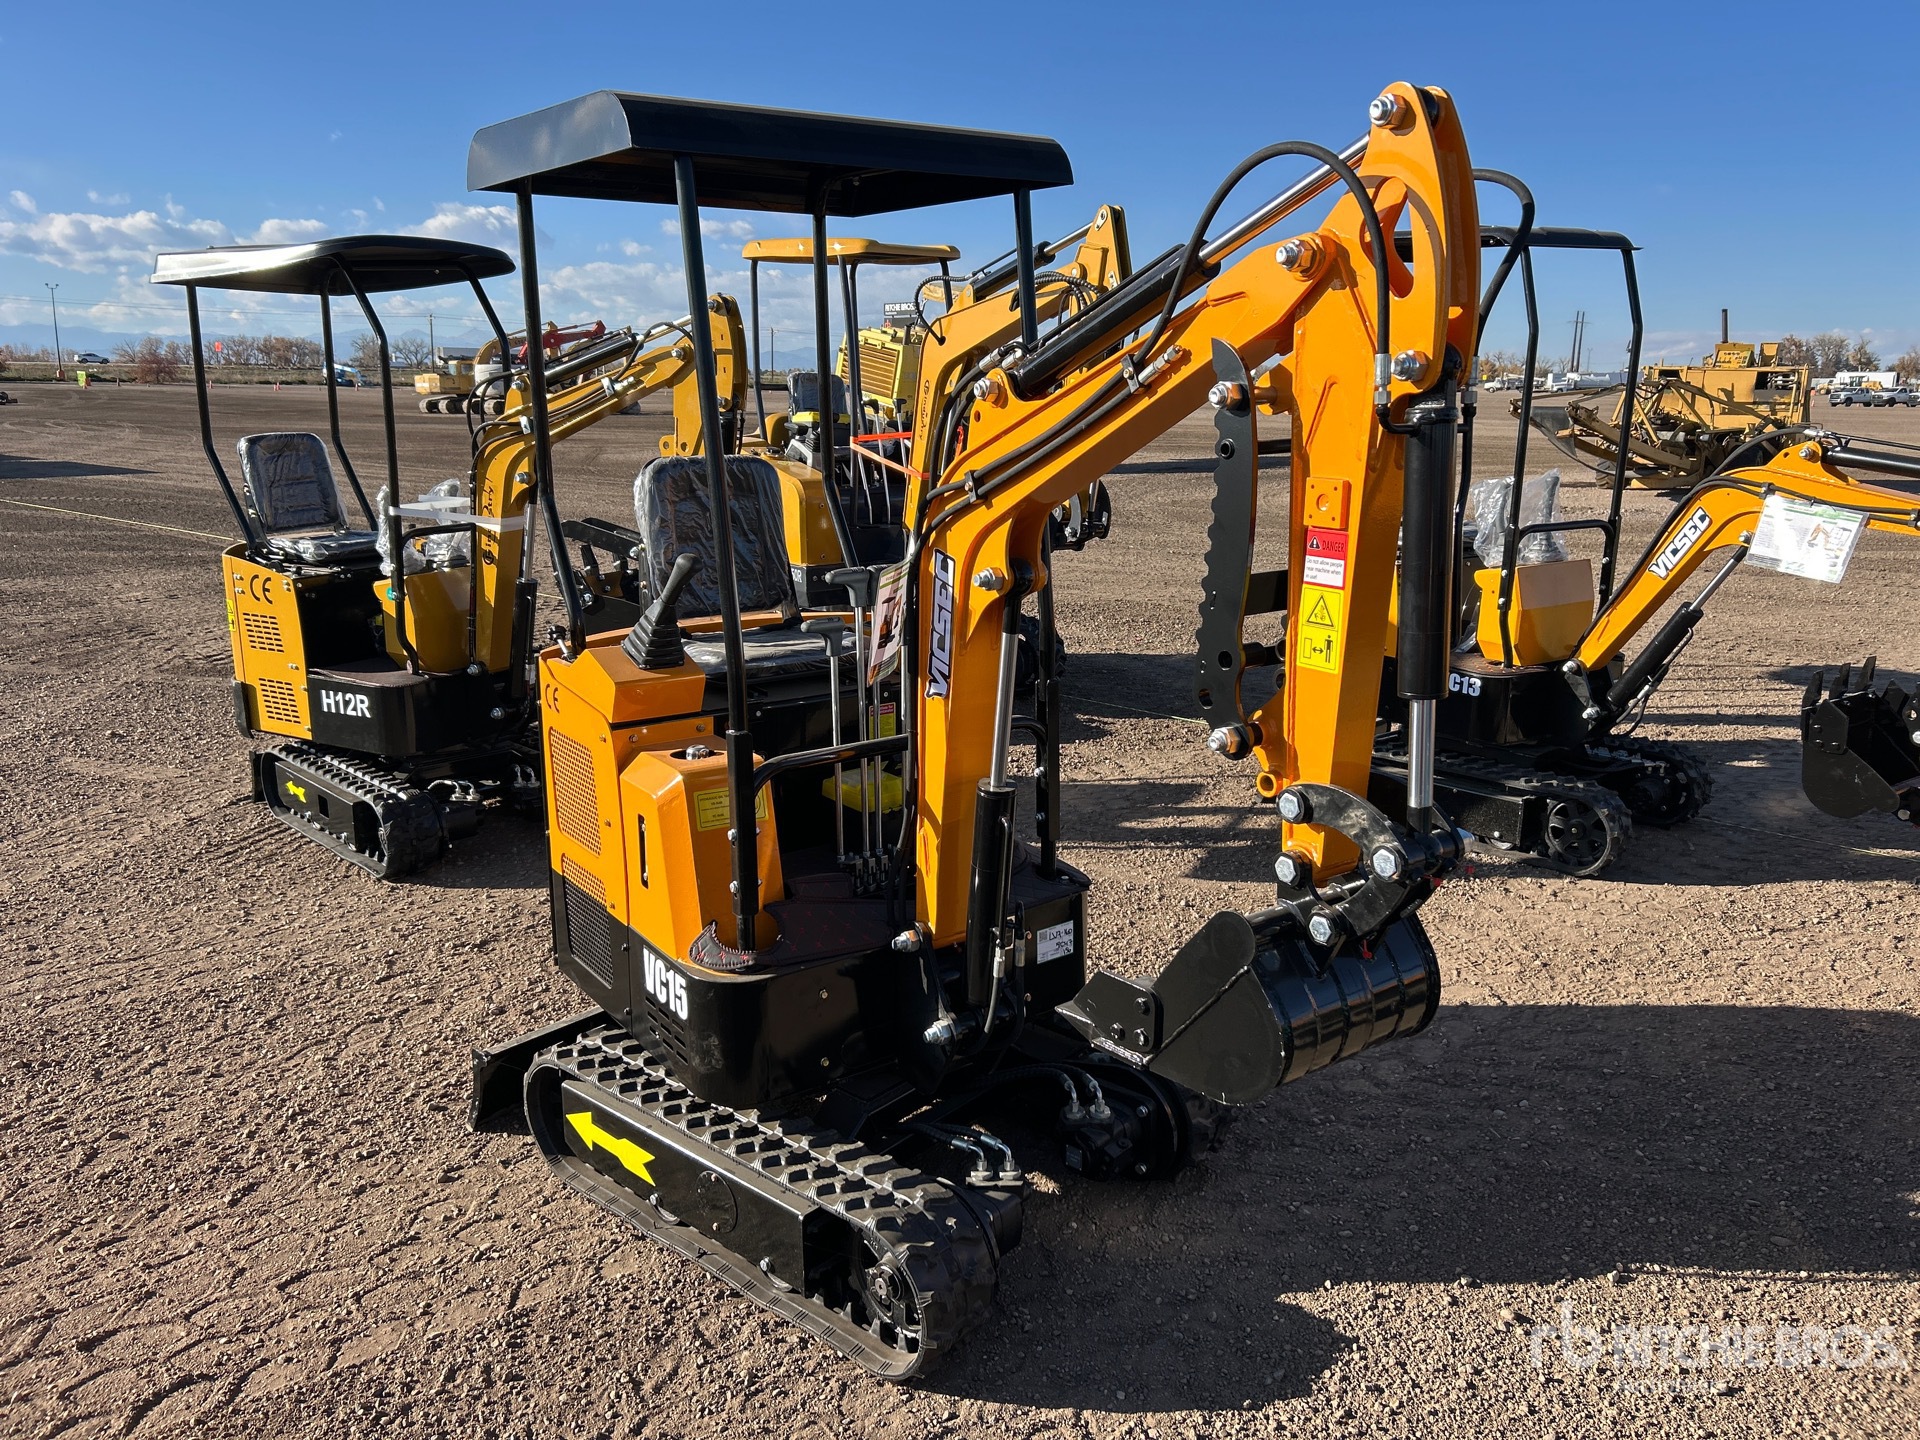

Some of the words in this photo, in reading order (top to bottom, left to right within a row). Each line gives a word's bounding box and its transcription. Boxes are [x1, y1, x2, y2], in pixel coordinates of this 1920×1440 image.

[1322, 540, 1345, 552] DANGER
[1648, 506, 1713, 580] VICSEC
[925, 549, 955, 698] VICSEC
[320, 689, 371, 718] H12R
[1449, 673, 1481, 697] C13
[643, 947, 688, 1020] VC15
